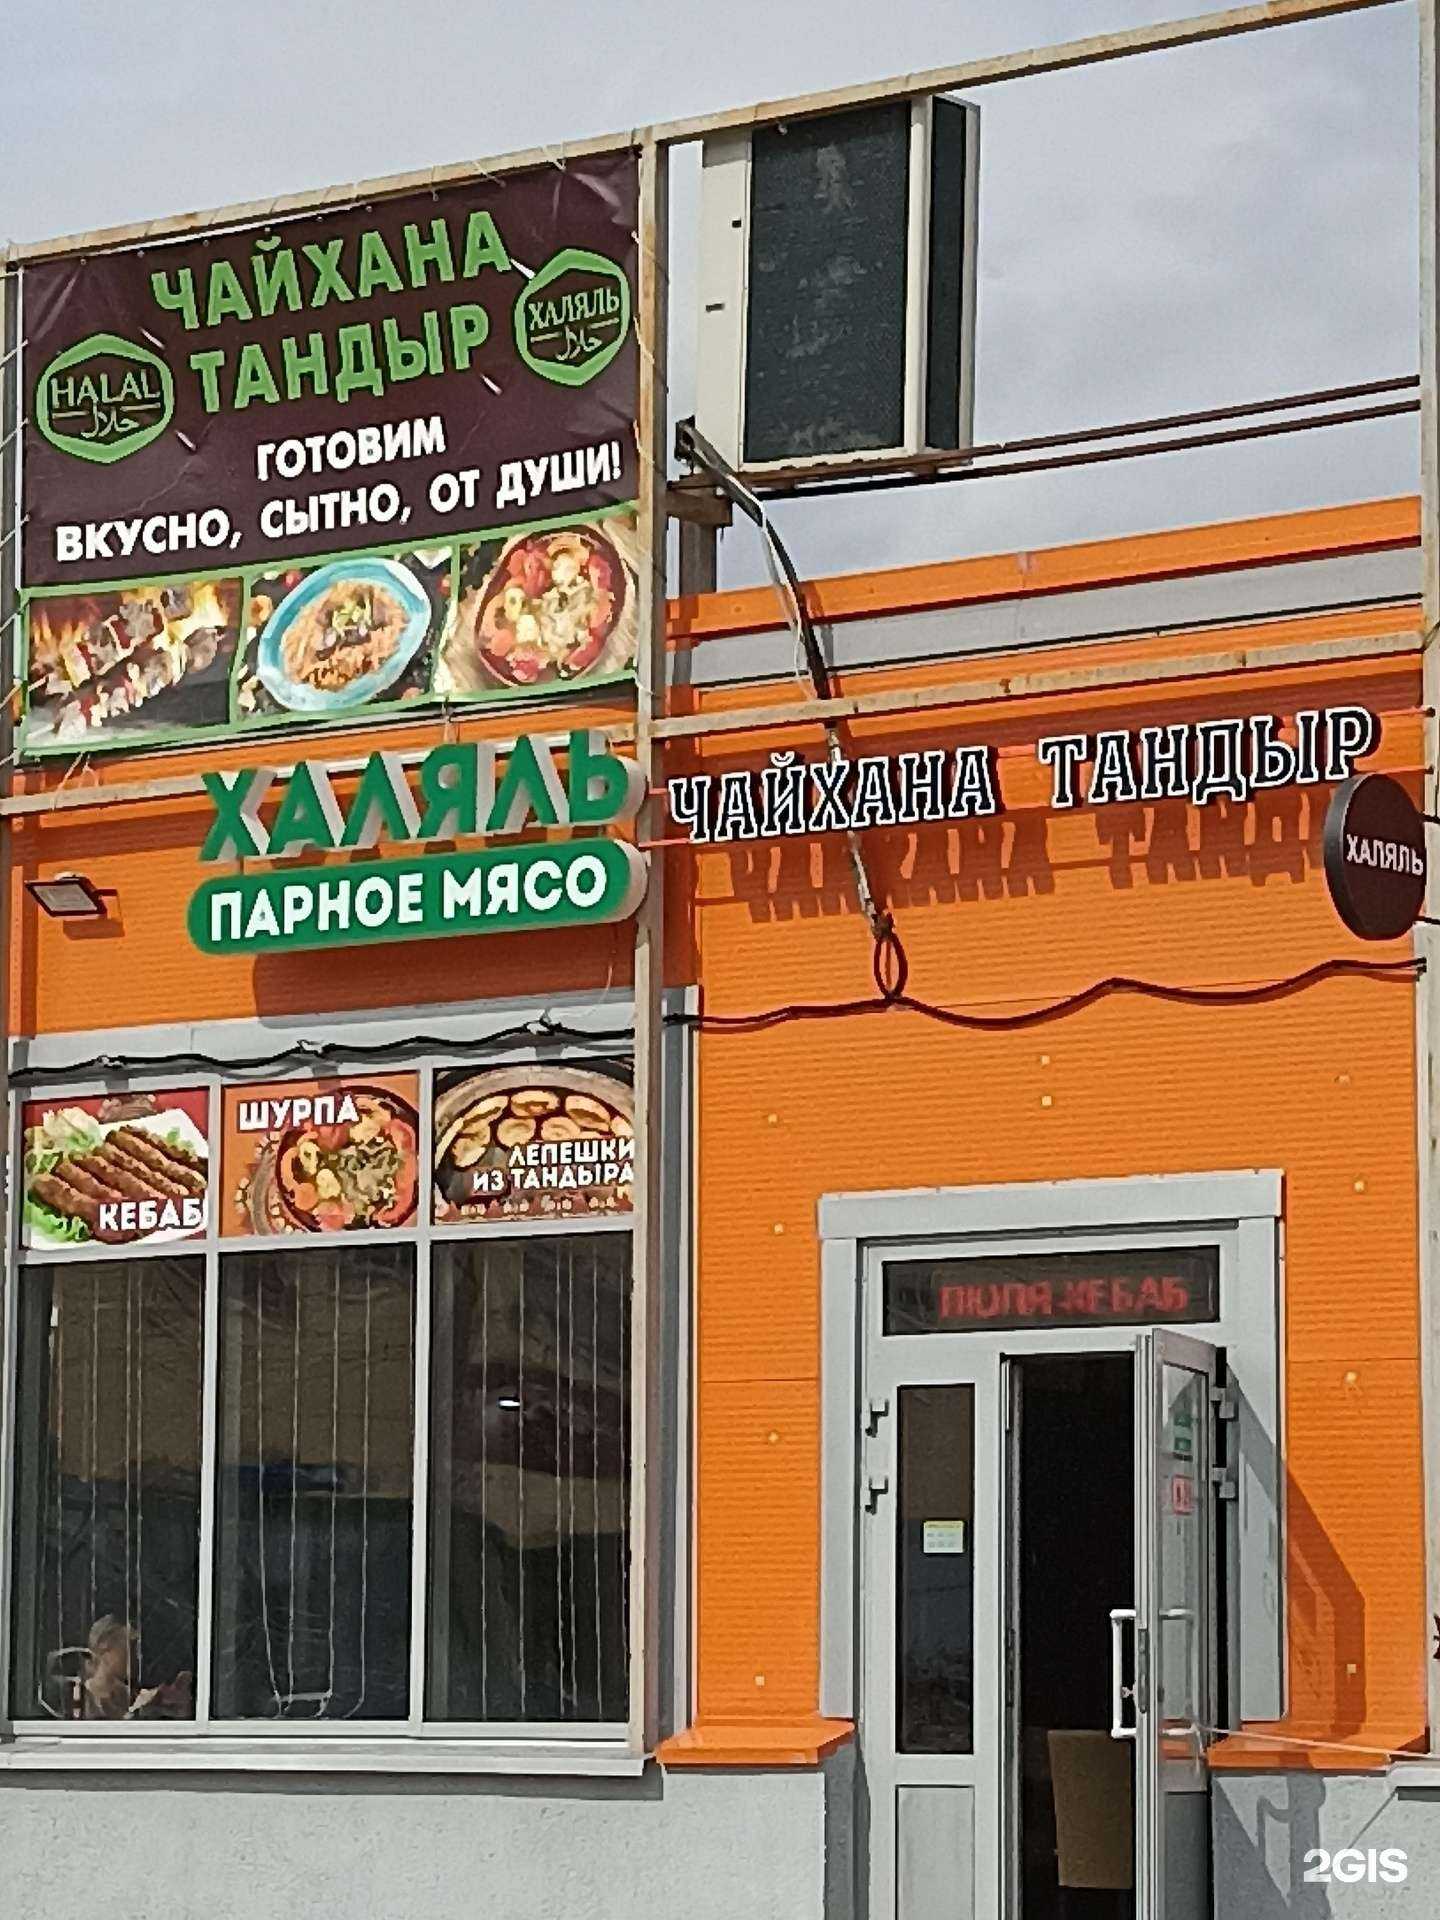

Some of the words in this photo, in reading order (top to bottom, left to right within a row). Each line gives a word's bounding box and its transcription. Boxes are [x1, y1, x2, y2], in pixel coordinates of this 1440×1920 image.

[151, 210, 511, 330] ЧАЙХАНА
[528, 287, 620, 331] ХАЛЯЛЬ
[190, 304, 490, 413] ТАНДЫР
[50, 369, 161, 409] HALAL
[256, 415, 446, 483] ГОТОВИМ
[55, 509, 242, 562] ВКУСНО,
[260, 484, 411, 539] СЫТНО,
[429, 467, 481, 513] ОТ
[496, 441, 623, 506] ДУШИ!
[199, 730, 640, 861] ХАЛЯЛЬ
[669, 746, 996, 843] ЧАЙХАНА
[1038, 706, 1374, 809] ТАНДЫР
[1346, 833, 1425, 876] ХАЛЯЛЬ
[209, 871, 424, 943] ПАРНОЕ
[442, 854, 608, 920] МЯСО
[238, 1094, 360, 1132] ШУРПА
[472, 1169, 506, 1194] ИЗ
[511, 1161, 635, 1190] ТАНДЫРА
[508, 1138, 636, 1168] ЛЕПЕШКИ
[99, 1198, 202, 1231] КЕБАБ
